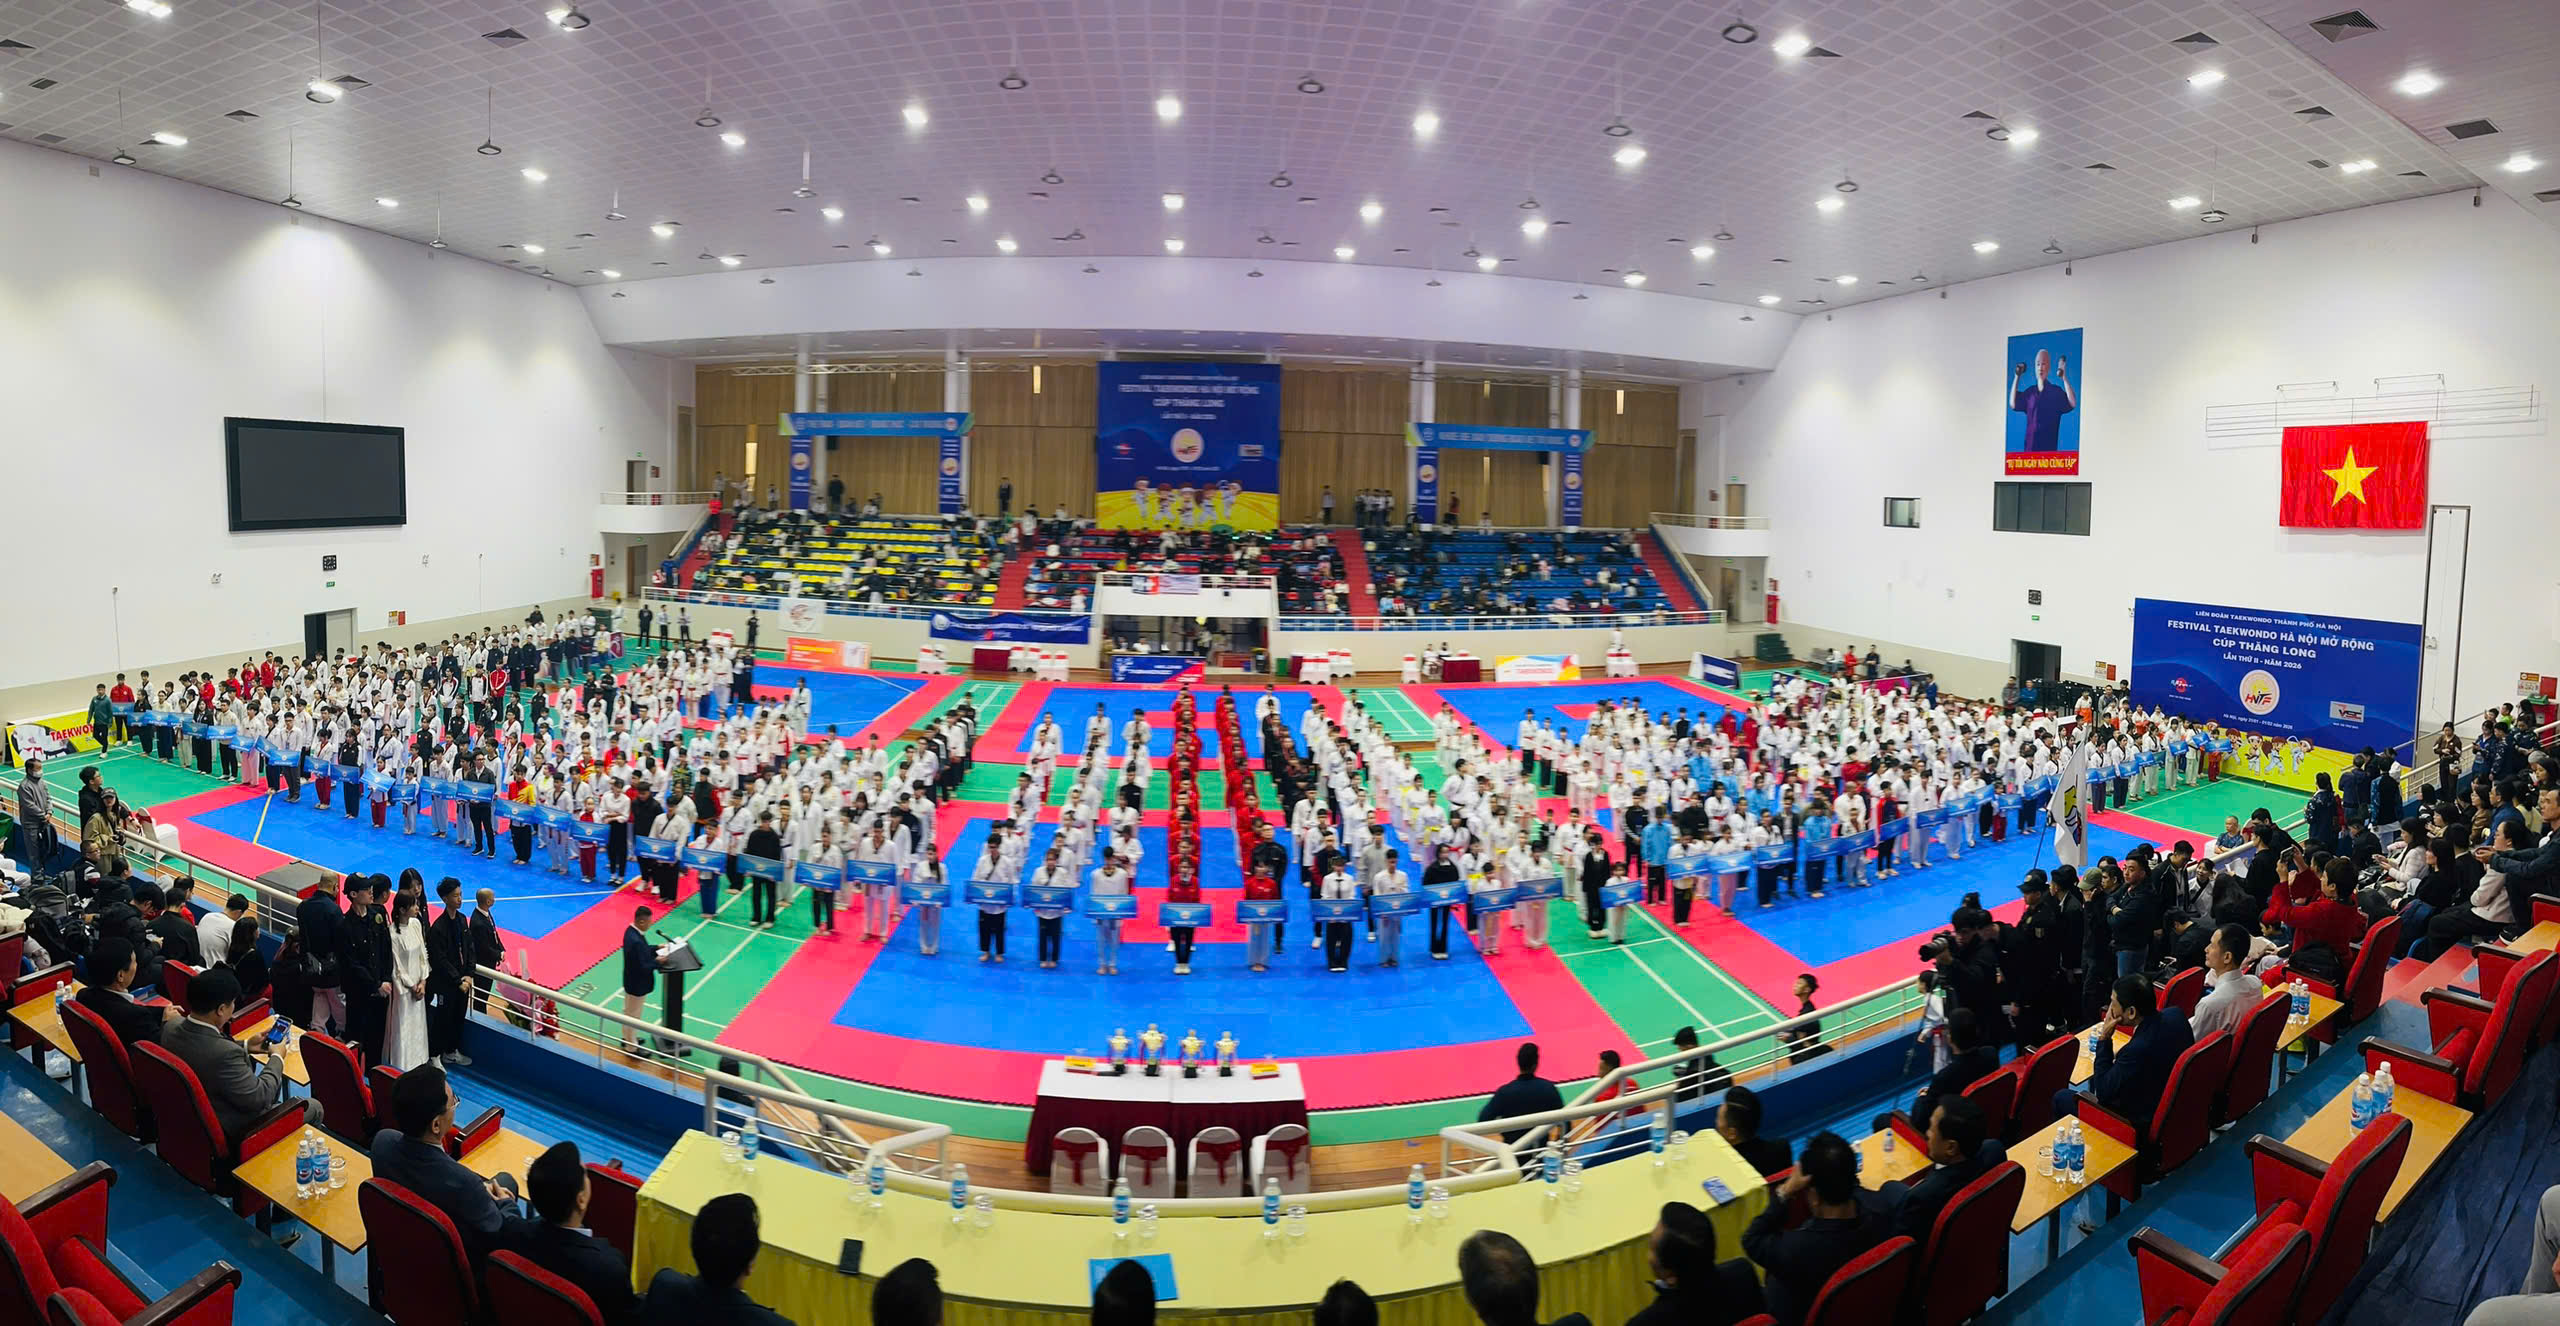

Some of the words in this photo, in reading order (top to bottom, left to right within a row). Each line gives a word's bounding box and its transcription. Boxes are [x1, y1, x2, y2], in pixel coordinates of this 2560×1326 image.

[2211, 611, 2229, 619] ĐOÀN
[2230, 614, 2272, 624] TAEKWONDO
[2274, 618, 2298, 626] THÀNH
[2299, 620, 2315, 628] PHỐ
[2167, 620, 2211, 633] FESTIVAL
[2214, 624, 2278, 640] TAEKWONDO
[2280, 631, 2295, 642] HÀ
[2298, 633, 2317, 646] NỘI
[2320, 635, 2339, 646] MỞ
[2341, 638, 2375, 651] RỘNG
[2213, 637, 2236, 648] CÚP
[2239, 641, 2279, 654] THĂNG
[2282, 646, 2317, 658] LONG
[2223, 651, 2237, 661] LẦN
[2238, 655, 2253, 663] THỨ
[2264, 658, 2282, 667] NĂM
[2283, 661, 2303, 669] 2026
[50, 723, 94, 742] TAEKWON
